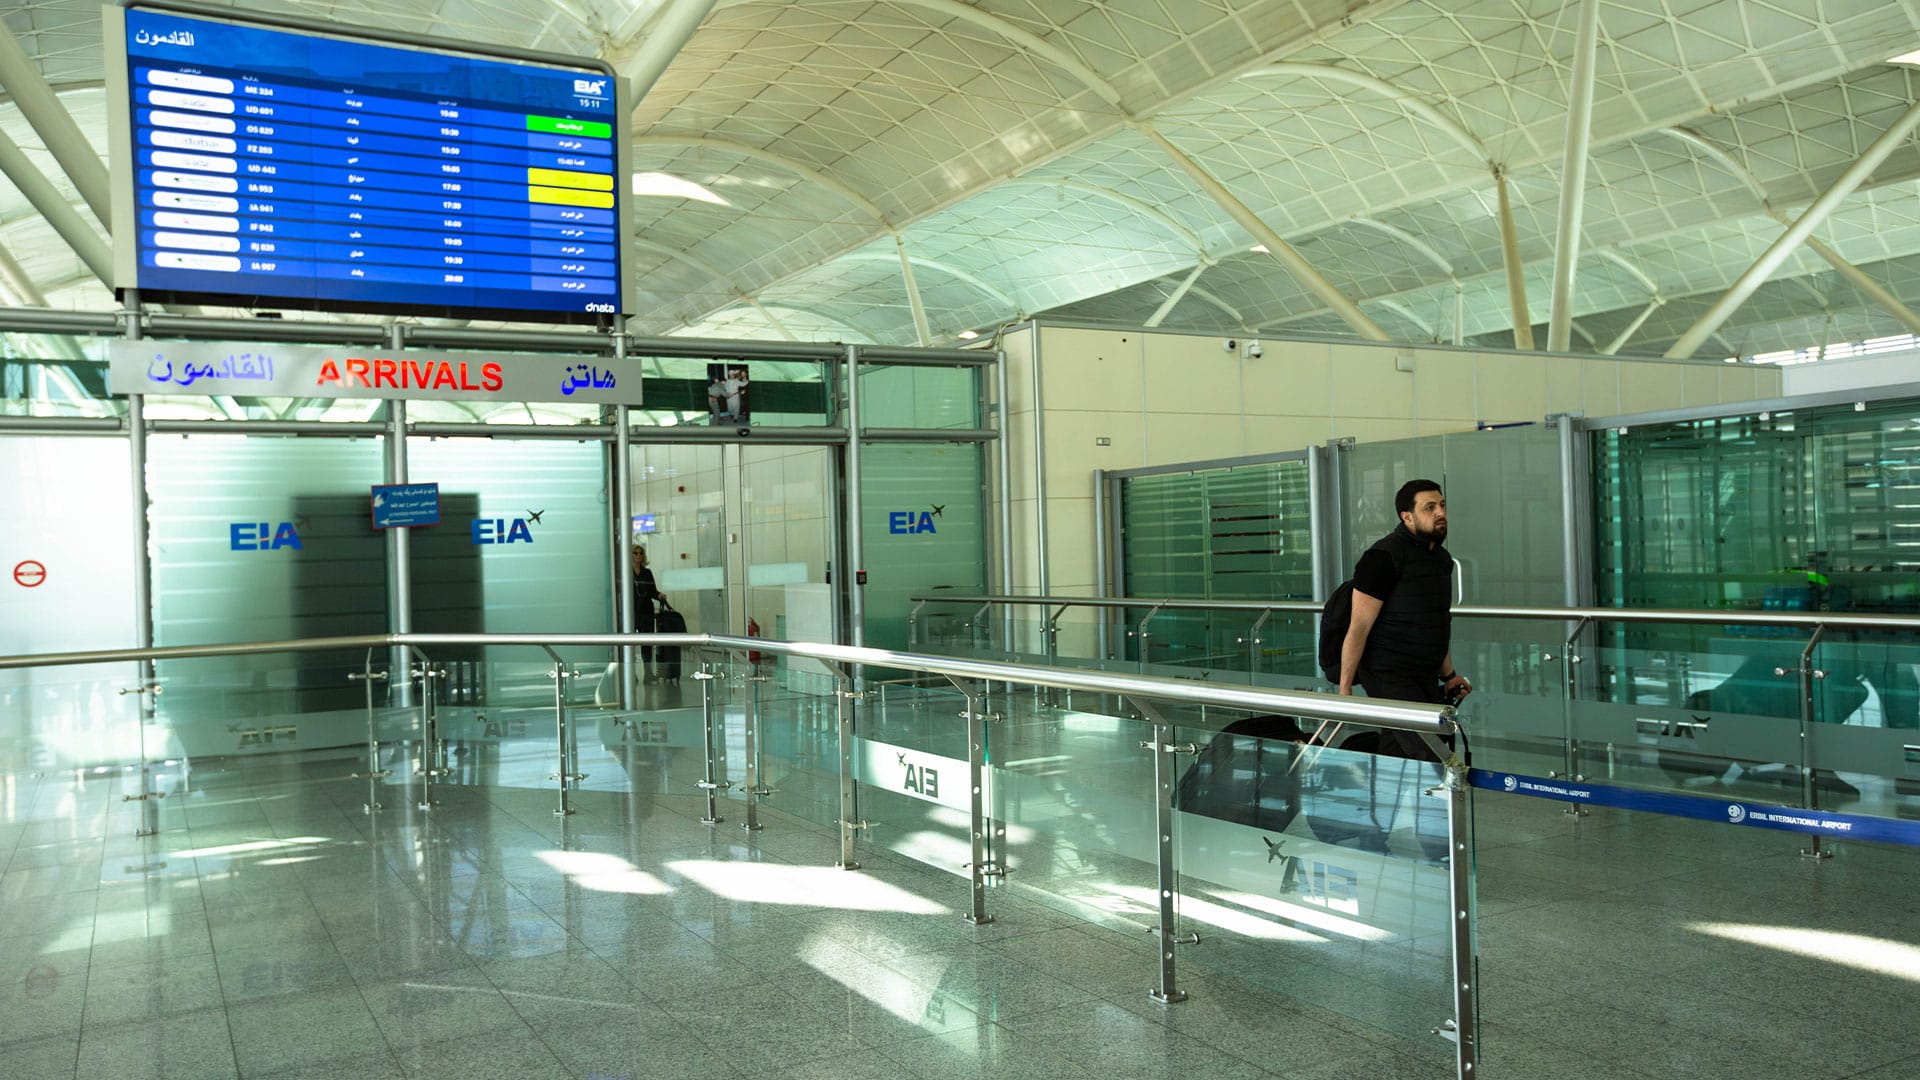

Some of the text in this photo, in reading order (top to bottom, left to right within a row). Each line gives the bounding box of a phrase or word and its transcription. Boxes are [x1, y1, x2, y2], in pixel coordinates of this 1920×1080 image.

[135, 29, 195, 46] القادمون
[574, 79, 602, 96] EIA
[585, 302, 615, 313] dnata
[147, 353, 273, 386] القادمون
[317, 357, 503, 391] ARRIVALS
[561, 364, 616, 396] هاتن
[471, 518, 533, 544] EIA
[889, 511, 937, 534] EIA
[230, 522, 303, 550] EIA
[1749, 811, 1852, 831] ERBIL INTERNATIONAL AIRPORT
